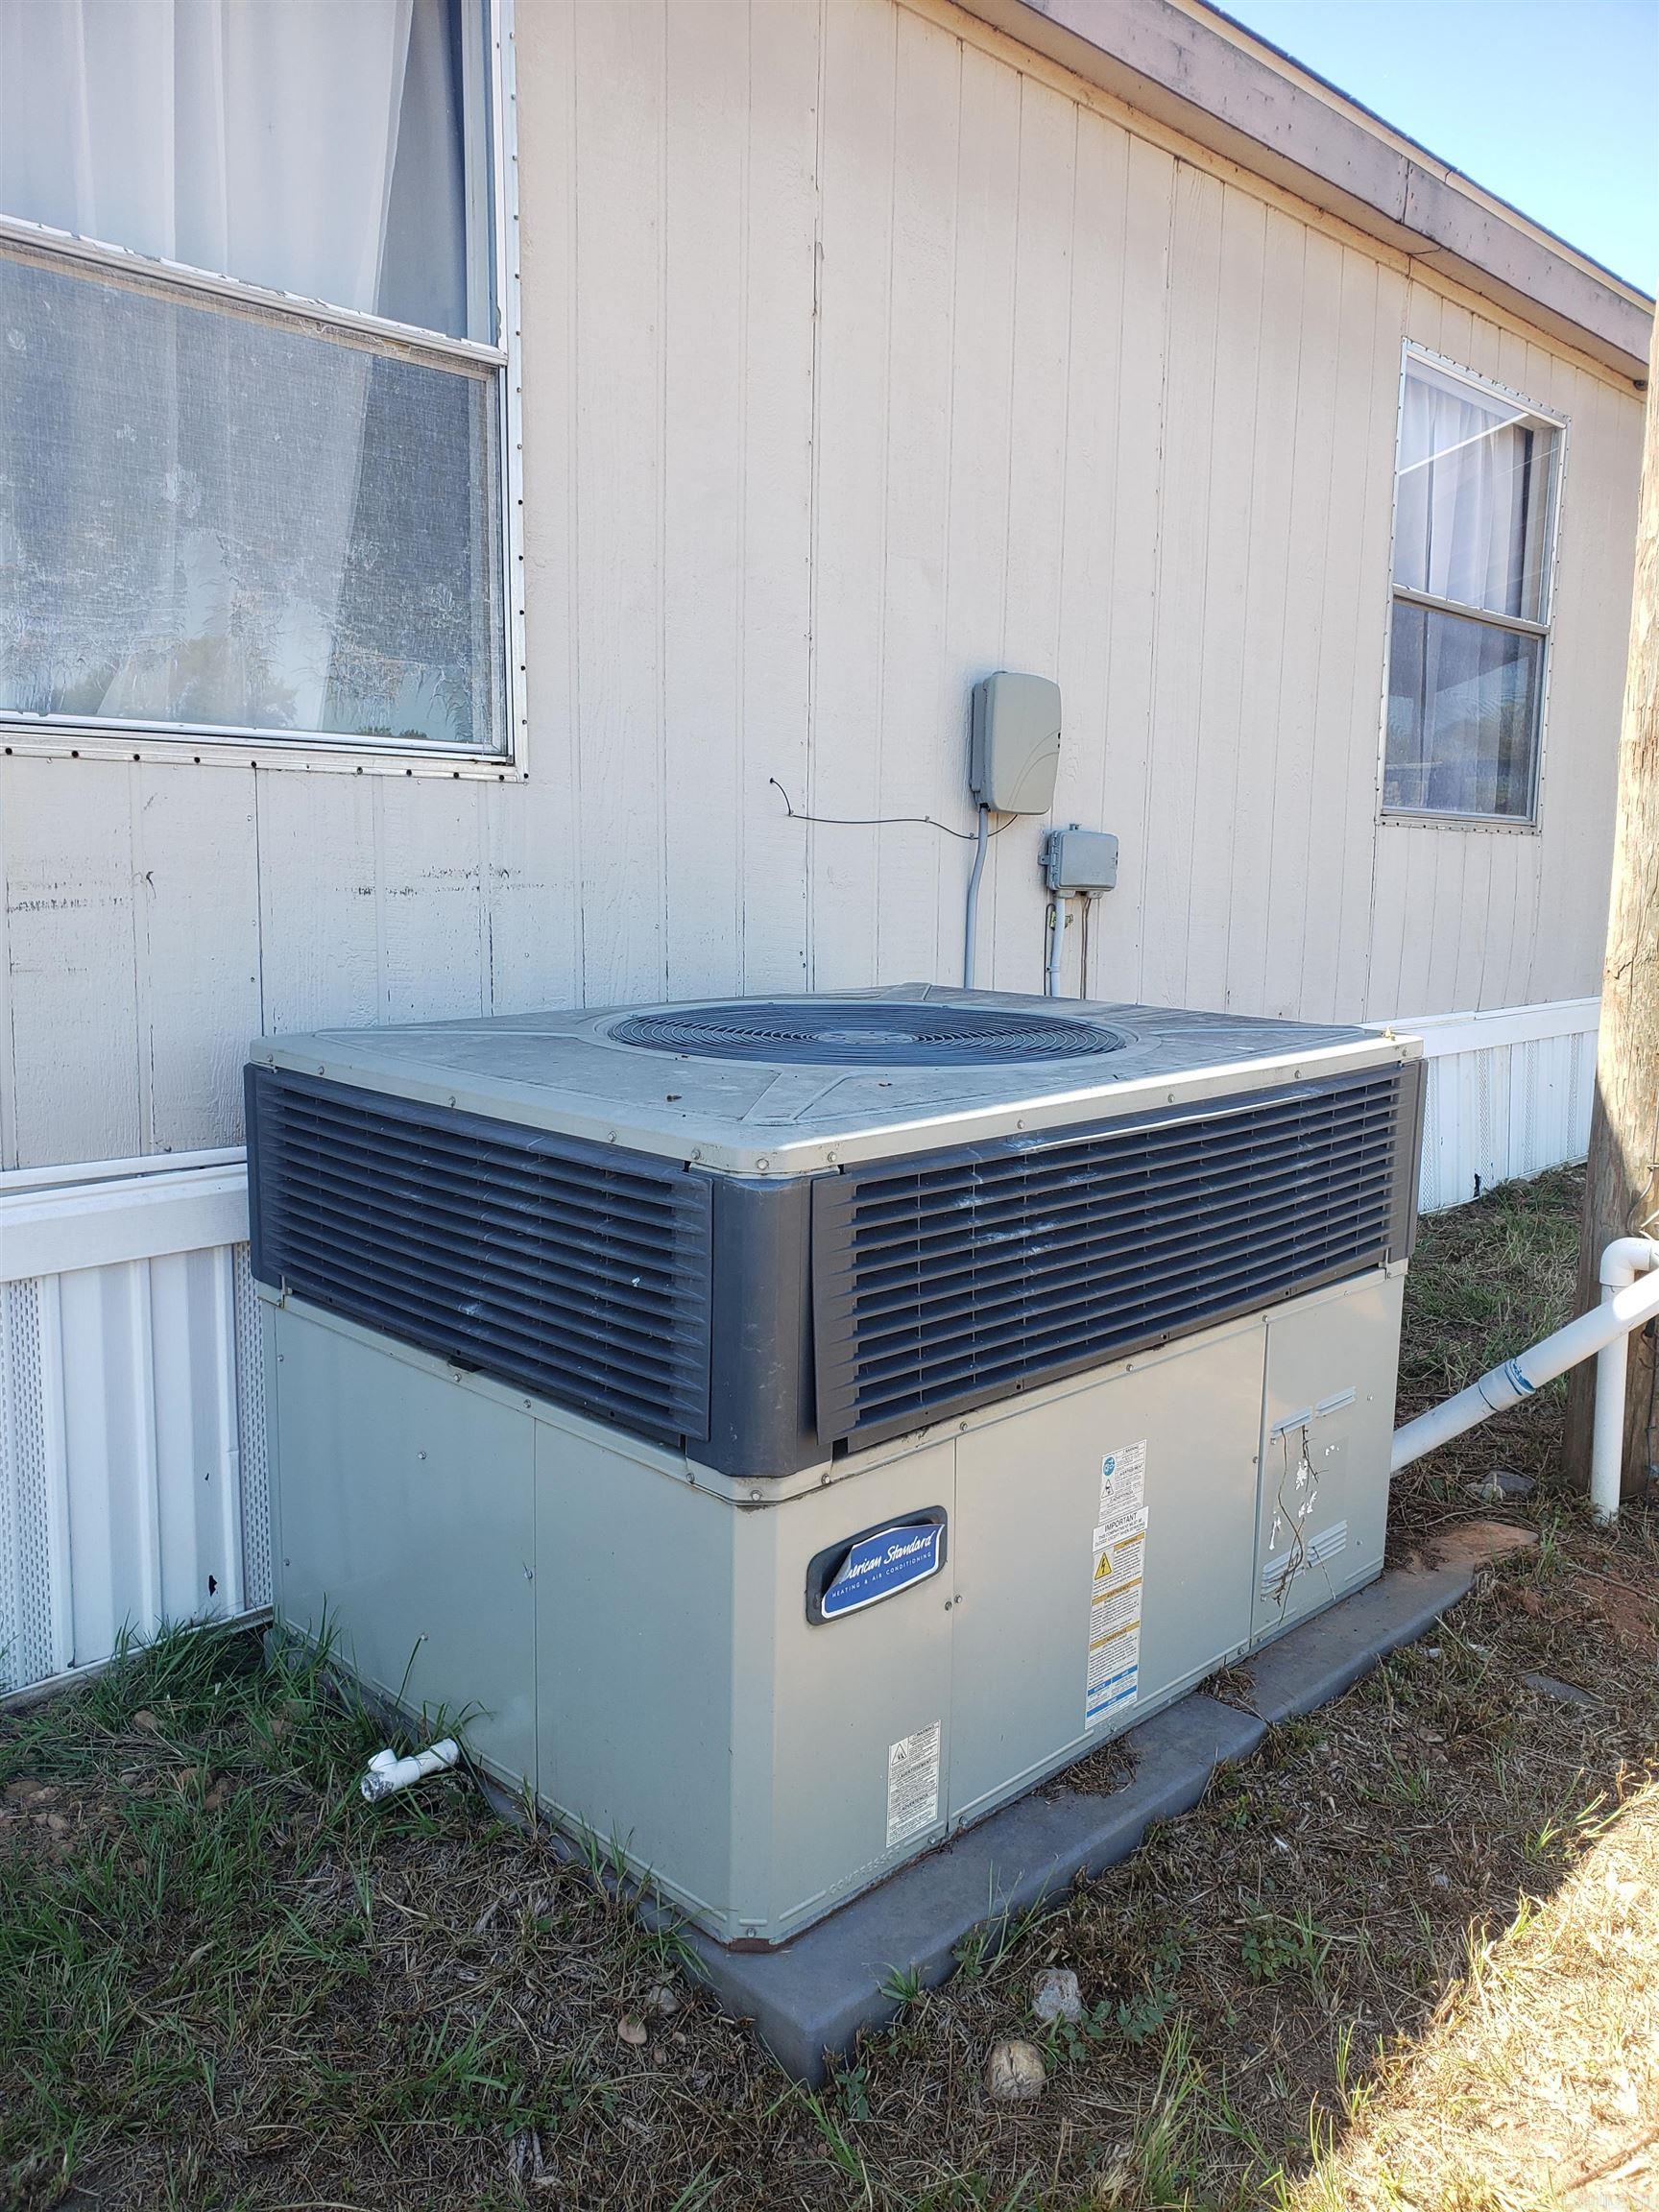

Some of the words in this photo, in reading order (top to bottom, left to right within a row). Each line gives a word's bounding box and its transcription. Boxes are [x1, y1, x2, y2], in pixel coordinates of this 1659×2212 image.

[1104, 1512, 1138, 1532] IMPORTANT
[884, 1530, 936, 1564] Standard
[831, 1582, 860, 1599] HEATING
[872, 1573, 882, 1581] AIR
[885, 1551, 932, 1575] CONDITIONING
